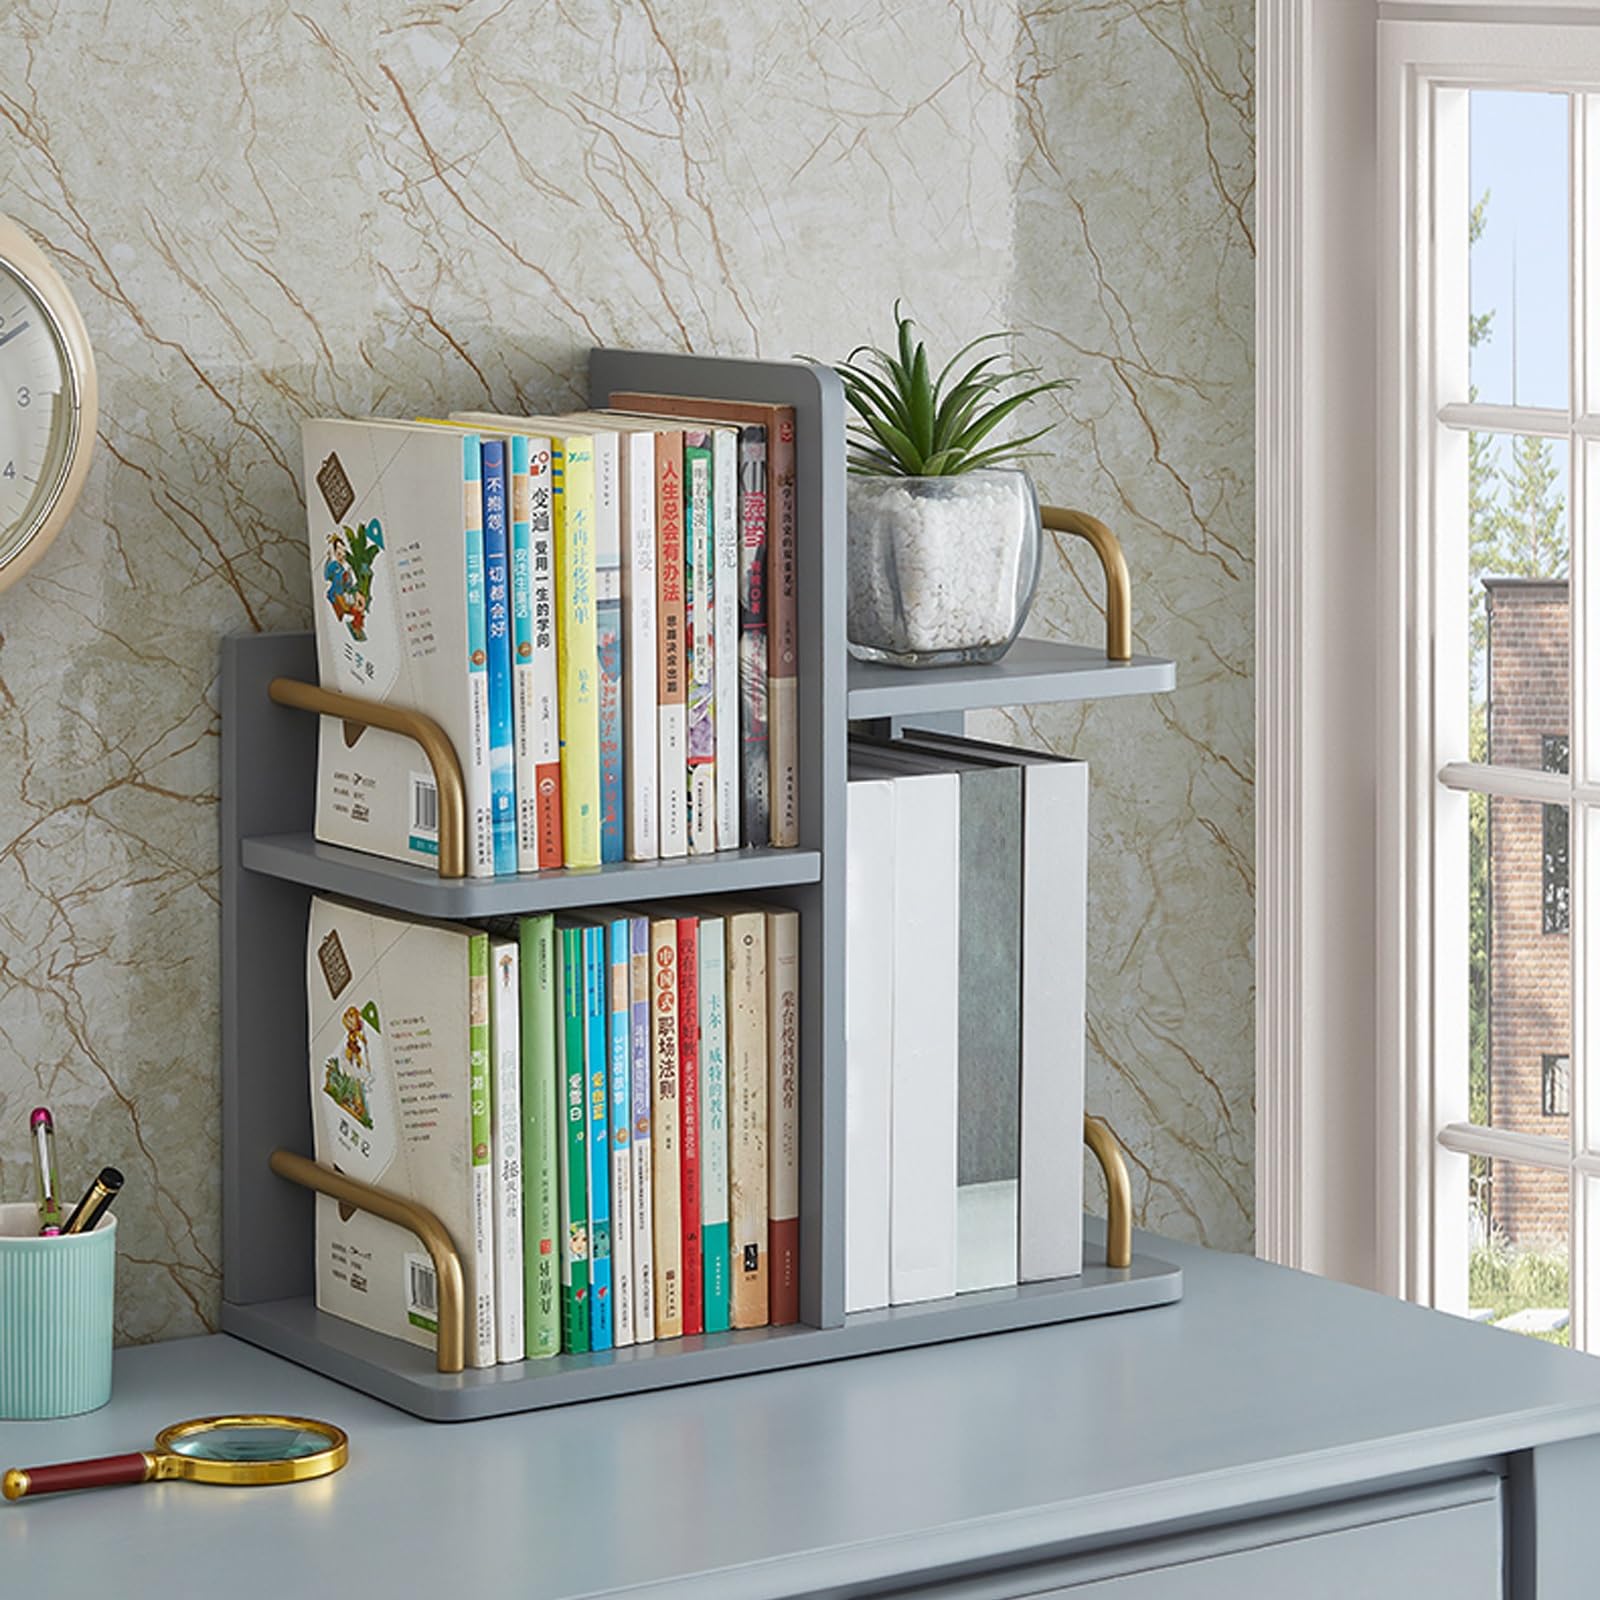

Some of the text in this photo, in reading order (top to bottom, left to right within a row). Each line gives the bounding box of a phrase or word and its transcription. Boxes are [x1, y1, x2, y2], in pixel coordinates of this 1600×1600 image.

[17, 385, 32, 408] 3
[2, 461, 17, 480] 4
[661, 459, 681, 603] 人生总会有办法
